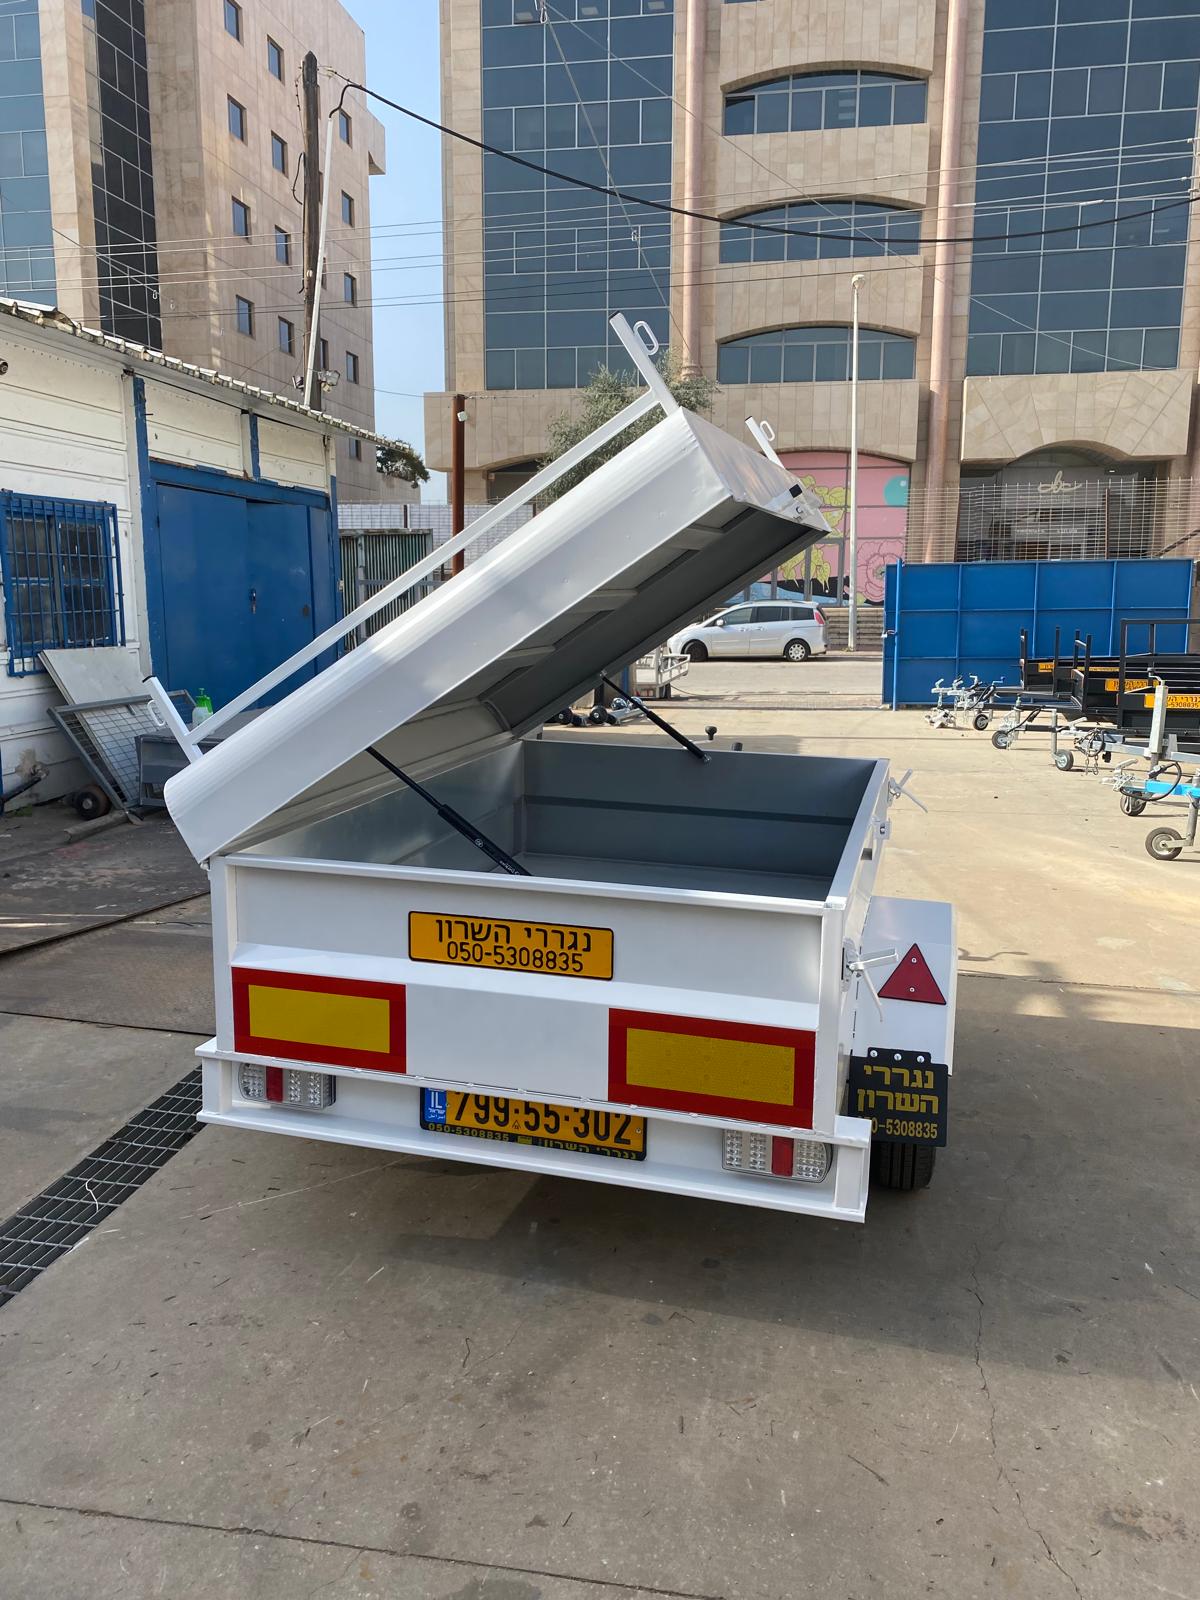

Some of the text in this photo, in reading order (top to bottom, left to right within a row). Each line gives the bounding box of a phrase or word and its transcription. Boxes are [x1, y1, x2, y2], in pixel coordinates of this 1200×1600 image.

[436, 919, 591, 952] נגררי השרון
[447, 941, 583, 972] 050-5308835
[863, 1064, 934, 1089] נגררי
[431, 1091, 443, 1109] IL
[857, 1088, 939, 1114] השרון
[428, 1122, 510, 1141] 050-5308835
[866, 1117, 938, 1139] 0-5308835
[543, 1138, 637, 1160] נגררי השרון
